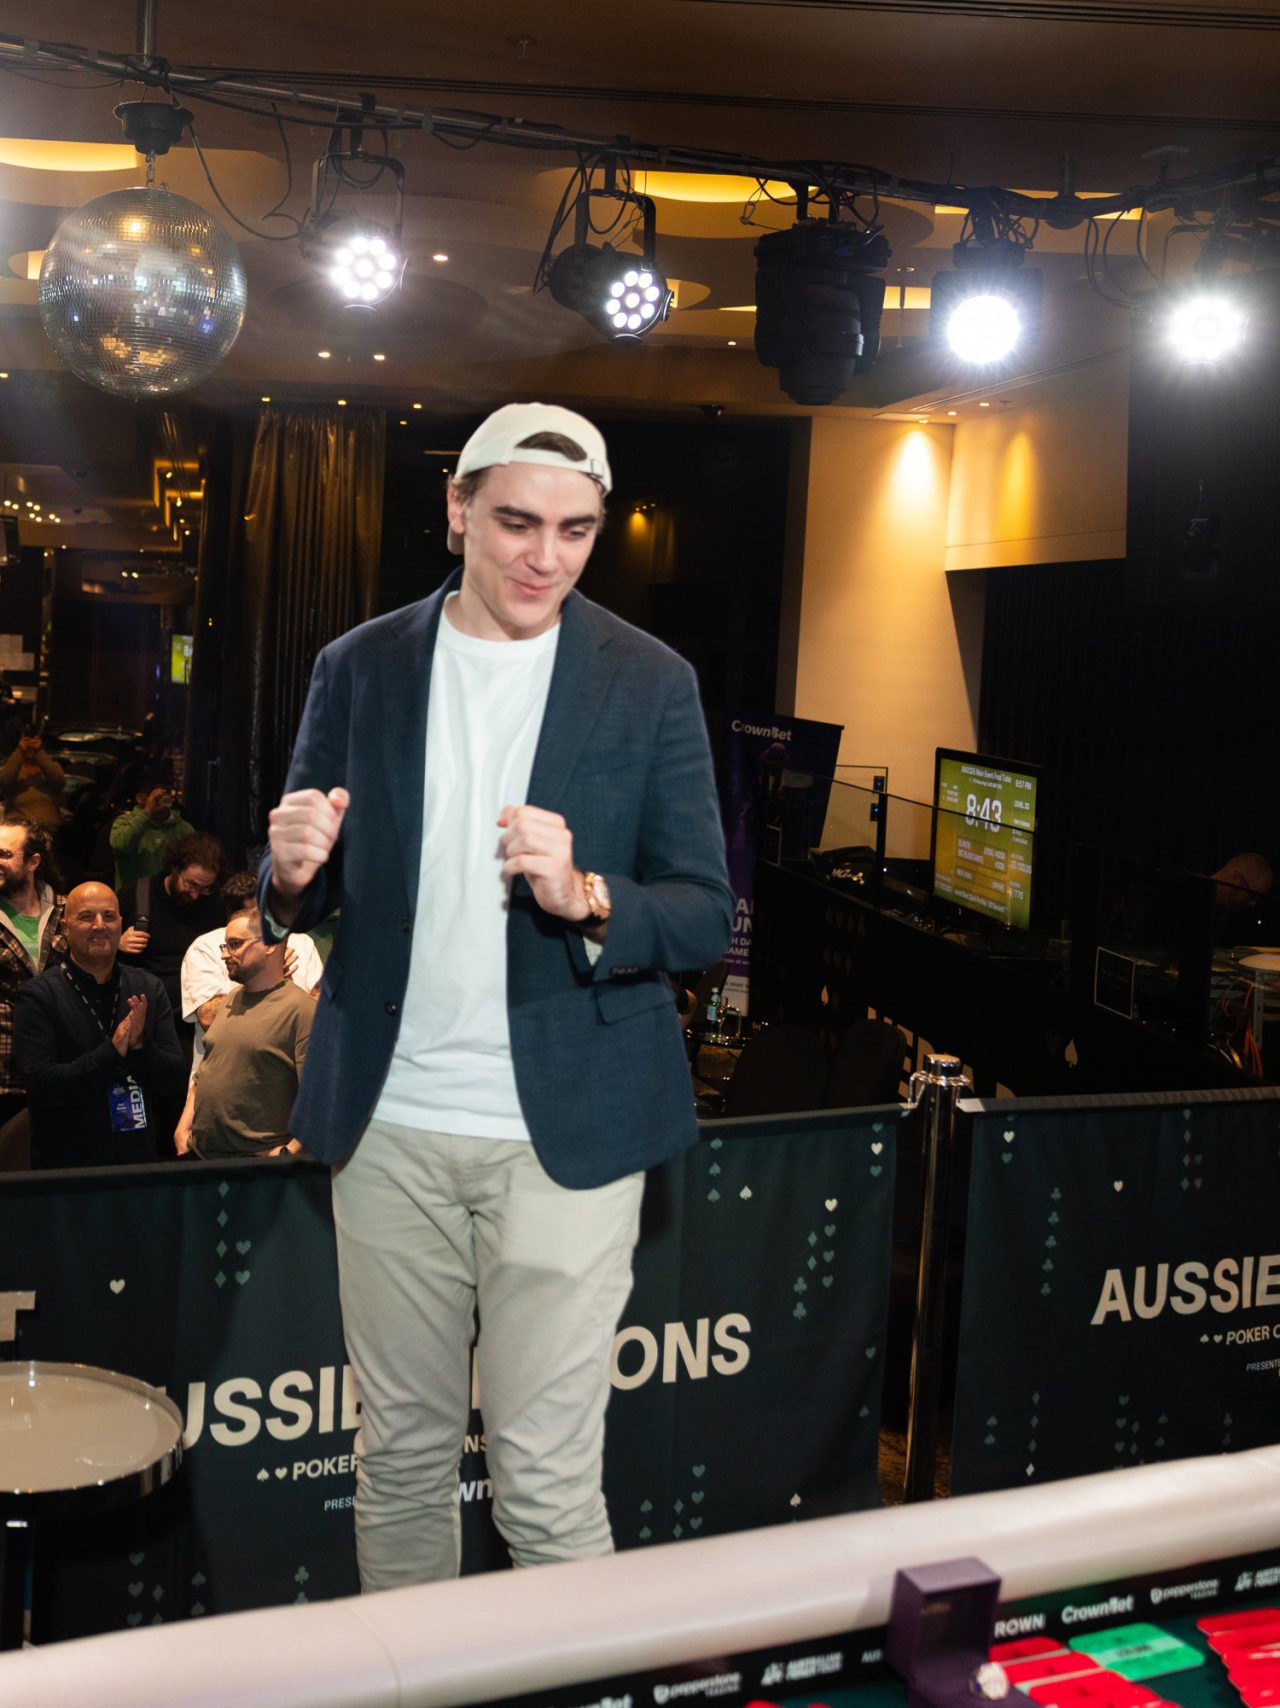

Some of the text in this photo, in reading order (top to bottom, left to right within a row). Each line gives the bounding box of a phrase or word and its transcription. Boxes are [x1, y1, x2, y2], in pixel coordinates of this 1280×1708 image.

[731, 719, 793, 742] CrownBet
[965, 793, 1003, 833] 8:43
[1090, 1253, 1280, 1326] AUSSIE
[1225, 1324, 1271, 1346] POKER
[610, 1312, 752, 1391] ONS
[1245, 1358, 1280, 1372] PRESENTE
[1061, 1595, 1135, 1625] CrownBet
[994, 1613, 1046, 1638] ROWN
